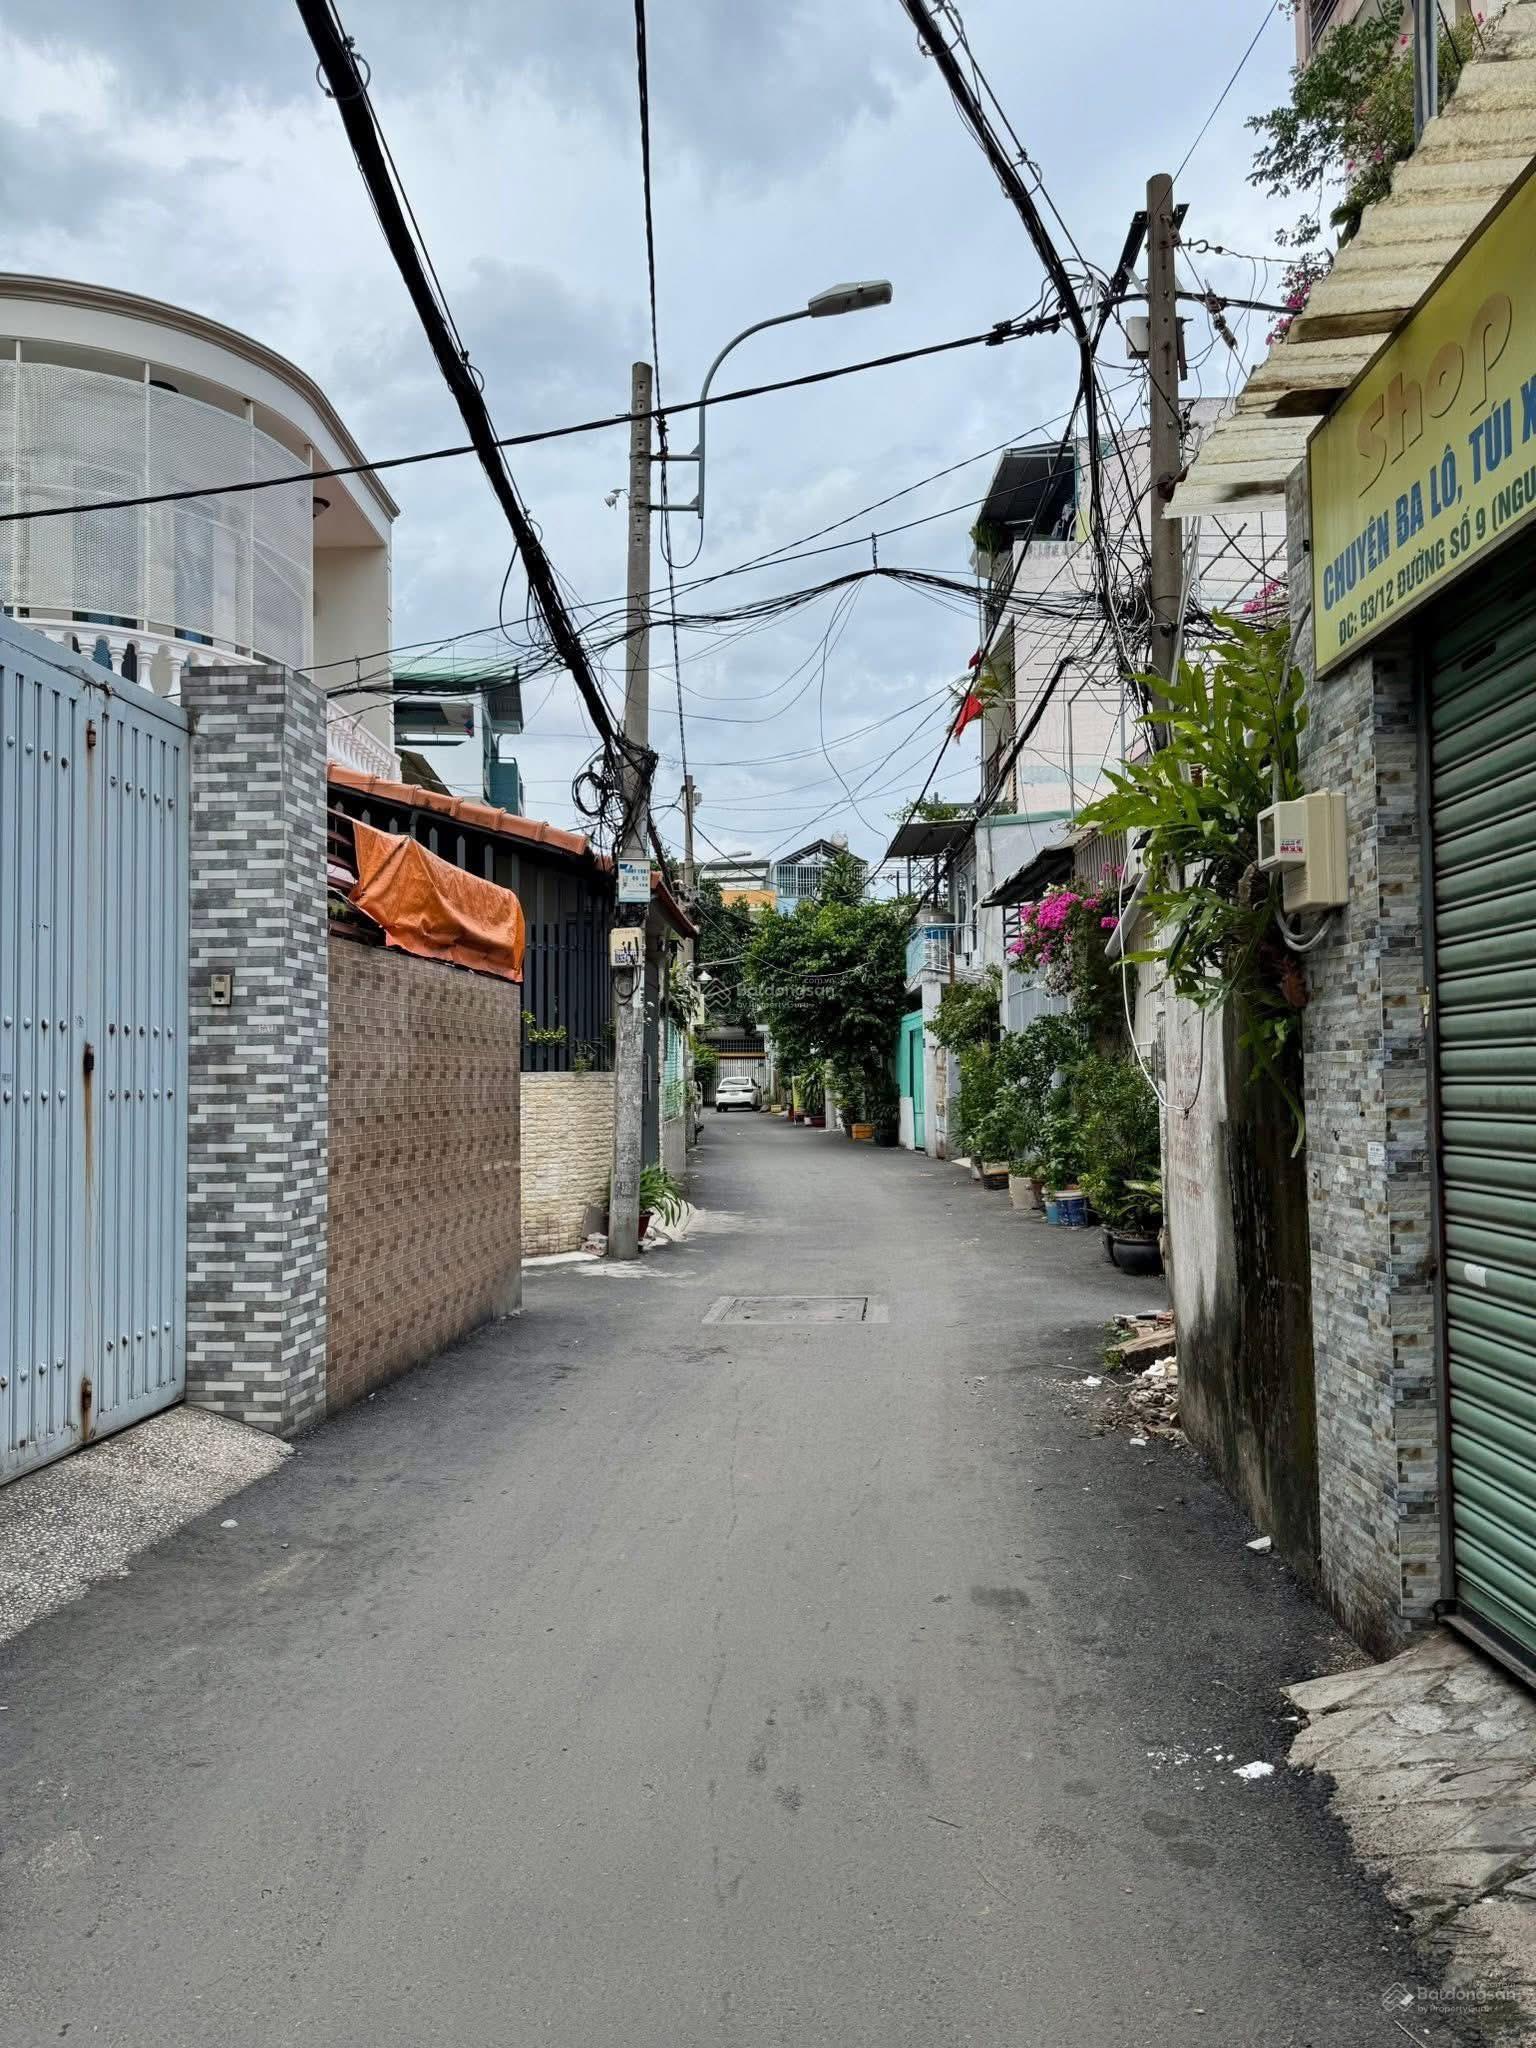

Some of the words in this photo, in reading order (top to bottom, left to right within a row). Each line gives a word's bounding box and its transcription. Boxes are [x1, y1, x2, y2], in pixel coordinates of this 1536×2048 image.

[1323, 509, 1390, 612] CHUYÊN
[1395, 480, 1424, 548] BA
[1430, 443, 1463, 519] LÔ,
[1468, 398, 1512, 484] TÚI
[1360, 579, 1394, 628] 93/12
[1397, 538, 1446, 599] ĐƯỜNG
[1450, 505, 1471, 559] SỐ
[1475, 507, 1486, 540] 9
